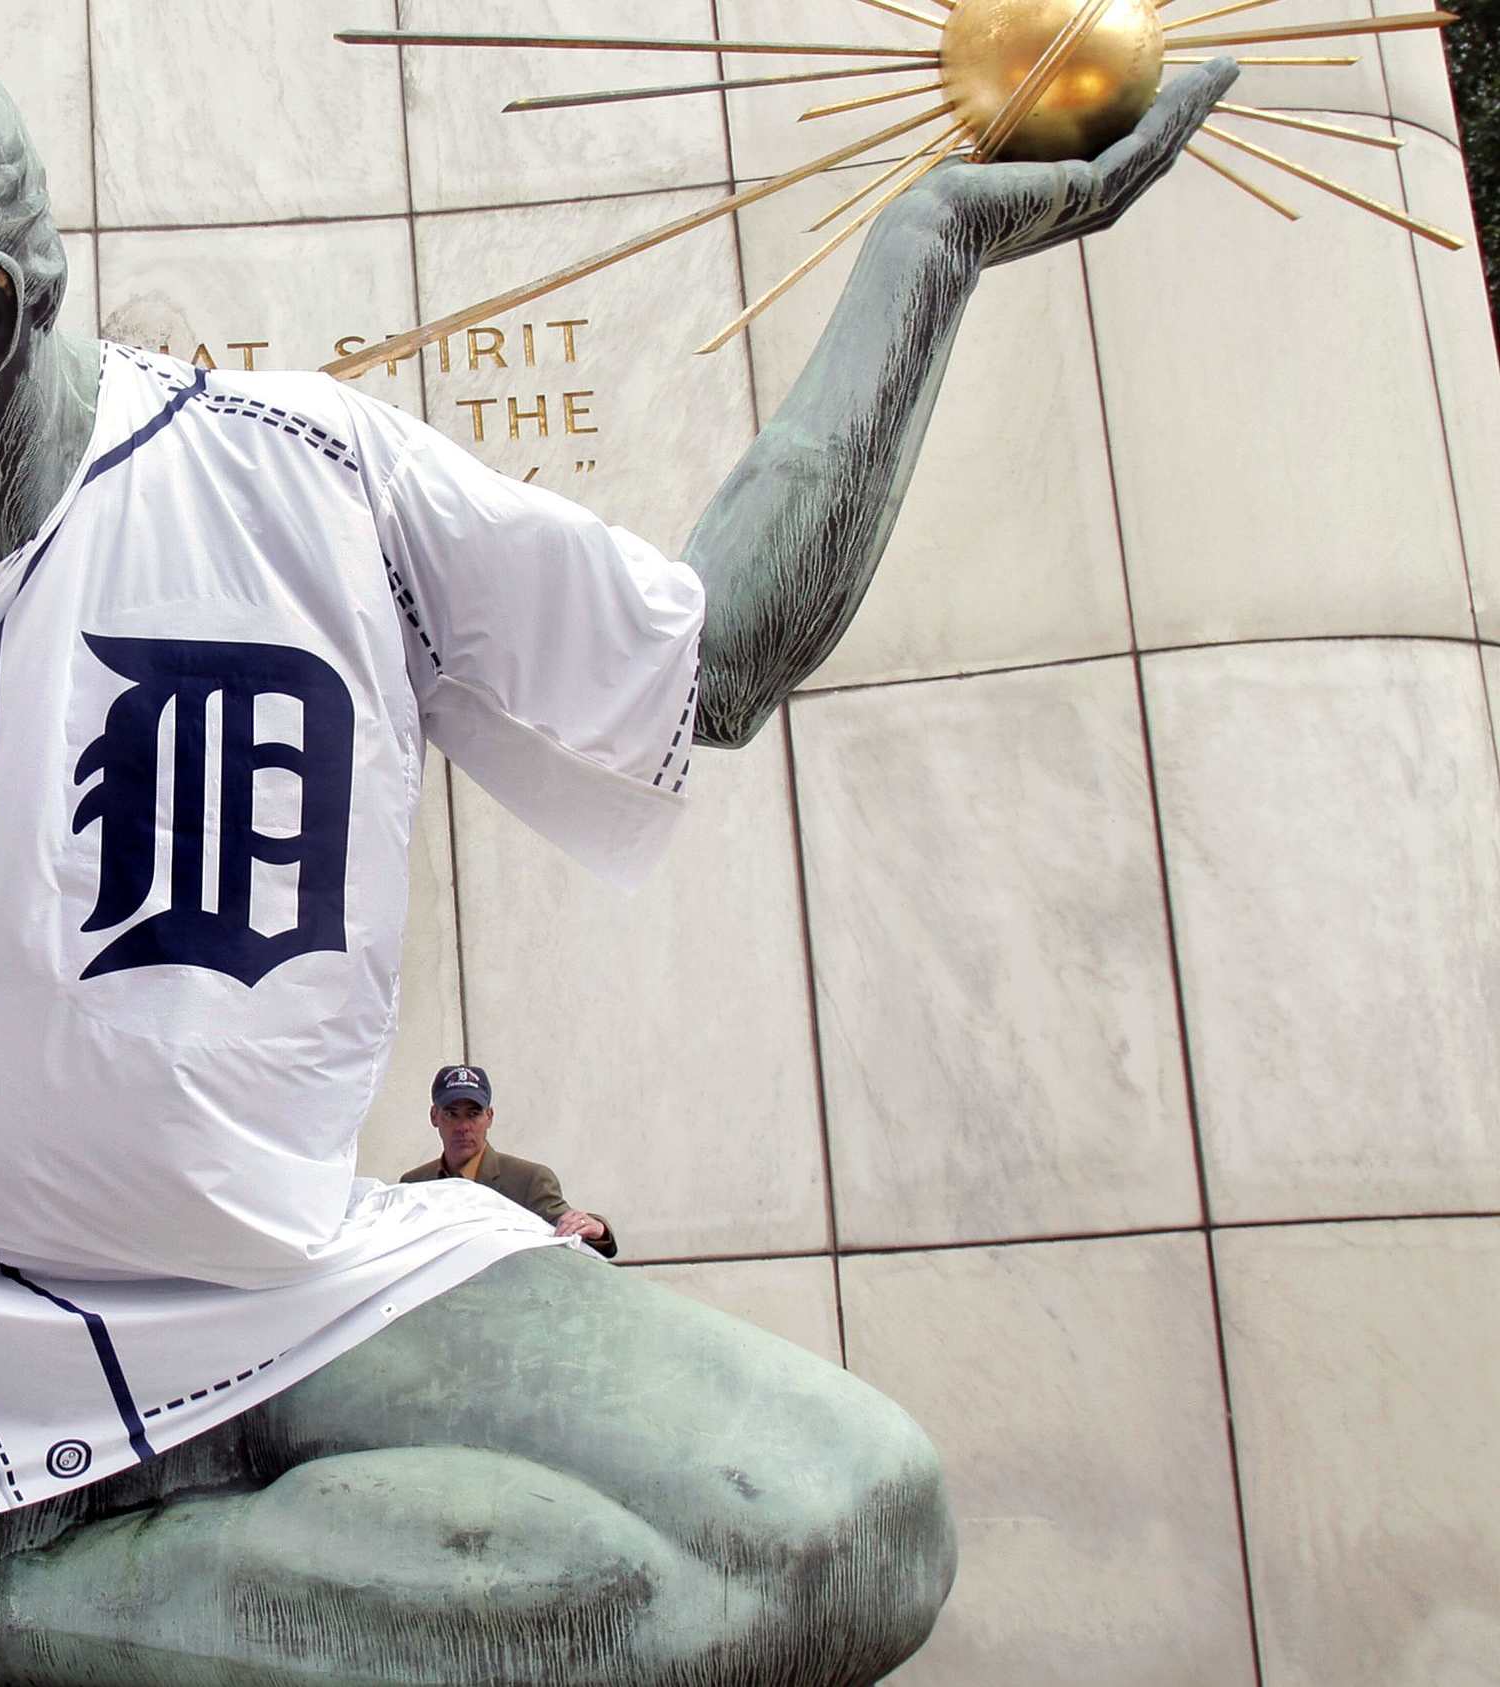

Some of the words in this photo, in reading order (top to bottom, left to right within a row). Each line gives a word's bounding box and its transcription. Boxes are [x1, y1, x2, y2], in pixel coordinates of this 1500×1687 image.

[159, 341, 269, 371] AT
[456, 391, 598, 442] THE
[72, 631, 355, 989] D
